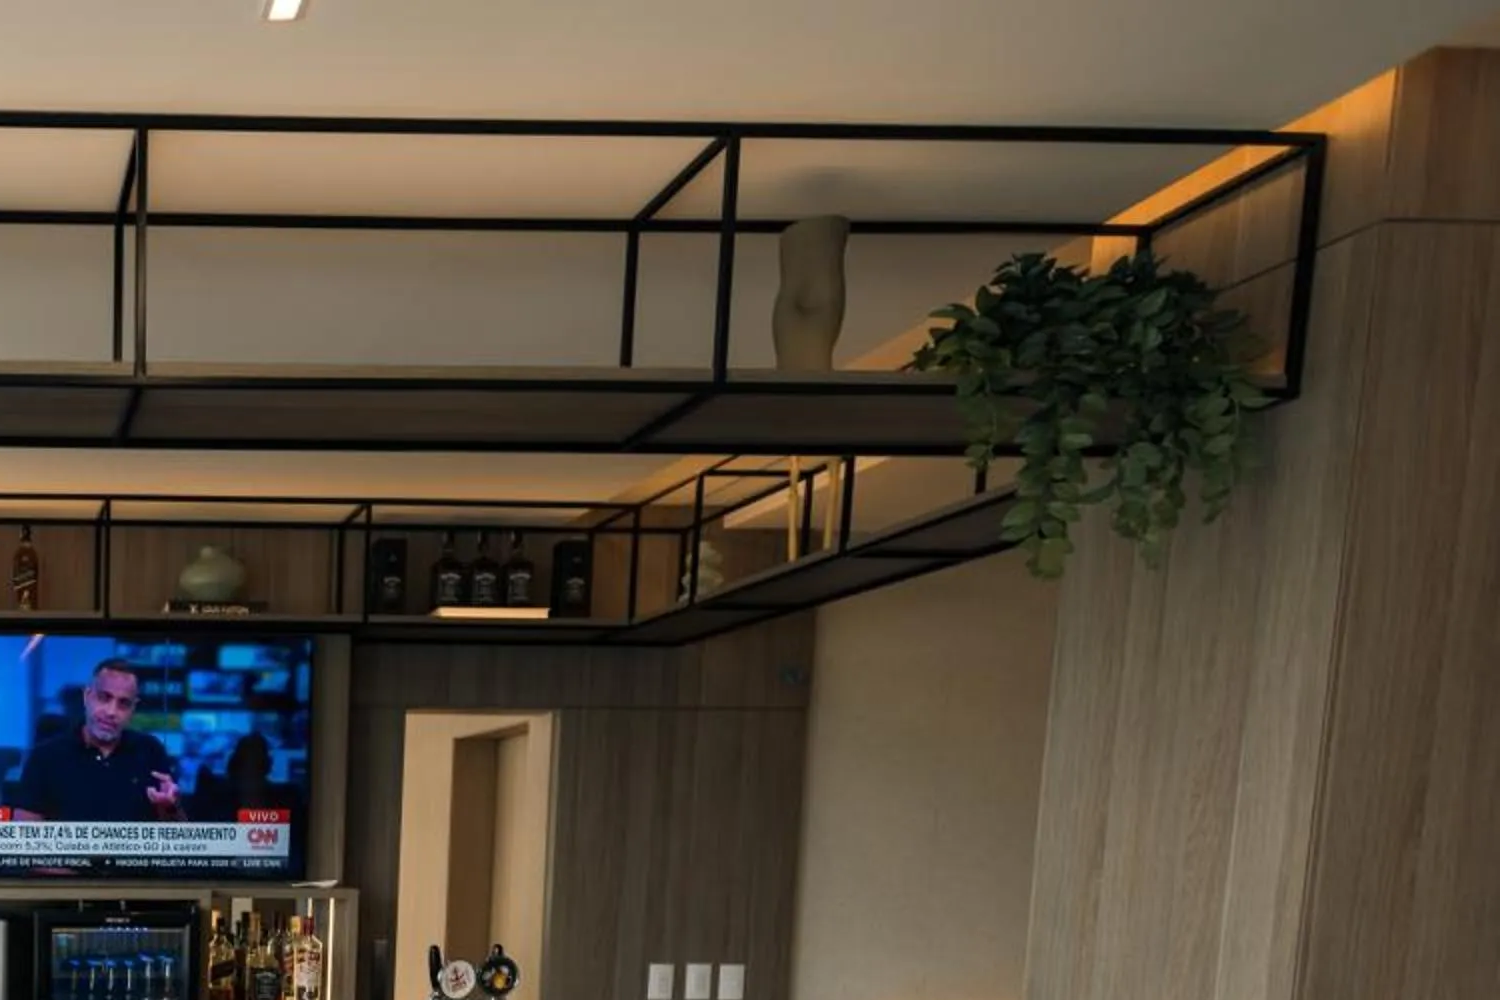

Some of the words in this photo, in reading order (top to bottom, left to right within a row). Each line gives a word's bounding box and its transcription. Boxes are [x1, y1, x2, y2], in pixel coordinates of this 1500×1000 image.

[249, 811, 279, 821] VIVO
[19, 825, 41, 839] TEM
[75, 826, 88, 839] DE
[91, 826, 139, 840] CHANCES
[141, 827, 156, 840] DE
[158, 827, 237, 840] REBAIXAMENTO
[247, 828, 279, 845] CNN
